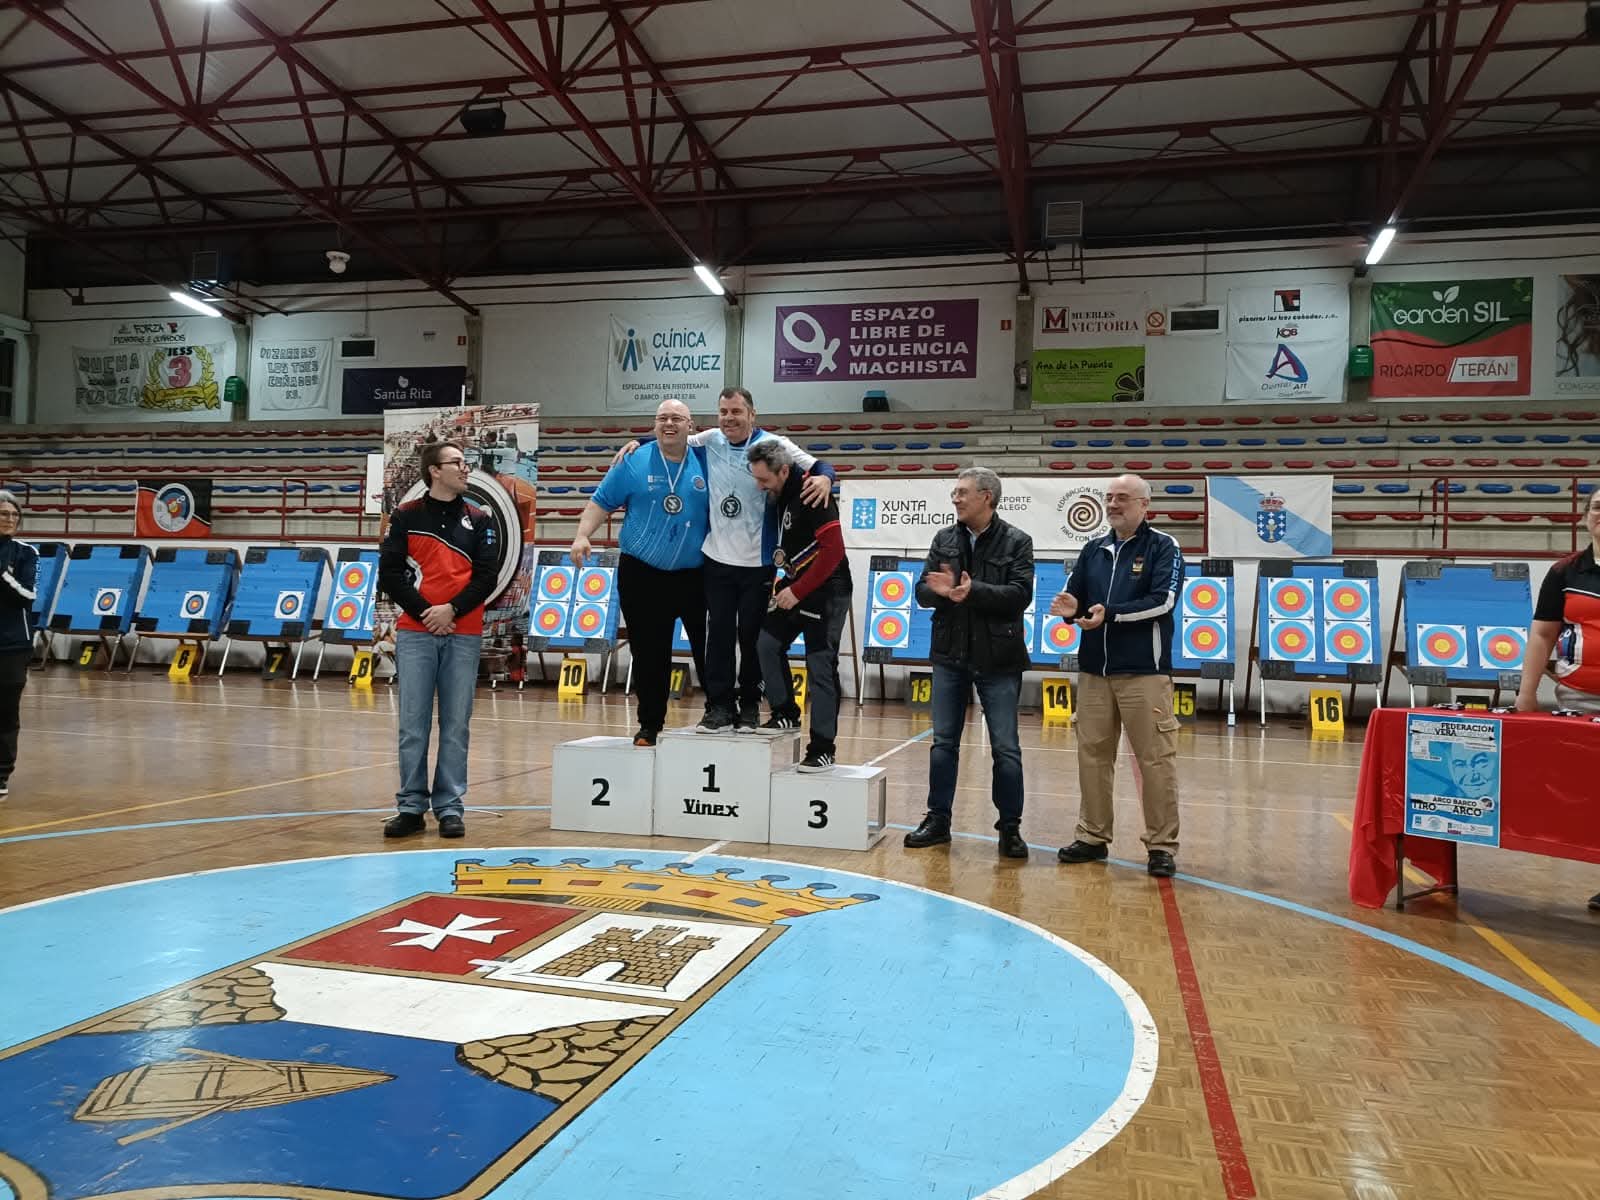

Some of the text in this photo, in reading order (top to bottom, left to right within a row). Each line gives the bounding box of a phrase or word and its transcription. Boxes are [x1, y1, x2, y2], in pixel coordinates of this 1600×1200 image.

[850, 306, 936, 322] ESPAZO
[1071, 311, 1116, 320] MUEBLES
[1473, 302, 1510, 323] SIL
[850, 324, 946, 340] LIBRE DE
[1071, 320, 1140, 333] VICTORIA
[850, 341, 970, 358] VIOLENCIA
[652, 352, 721, 374] VÁZQUEZ
[848, 359, 968, 376] MACHISTA
[1081, 359, 1113, 370] Puente
[1379, 361, 1510, 378] RICARDO TERÁN
[168, 356, 193, 388] 3
[374, 386, 432, 400] Santa Rita
[622, 383, 662, 391] ESPECIALISTAS
[662, 383, 671, 391] EN
[882, 500, 927, 512] XUNTA
[998, 503, 1028, 511] ALEGO
[881, 512, 955, 525] DE GALICIA
[79, 646, 93, 666] 5
[176, 650, 190, 669] 6
[269, 654, 283, 673] 7
[355, 658, 370, 678] 8
[563, 664, 583, 687] 10
[911, 679, 931, 703] 13
[1045, 685, 1069, 709] 14
[1173, 690, 1195, 716] 15
[1314, 696, 1340, 723] 16
[1435, 729, 1458, 738] VERA
[1440, 722, 1495, 734] FEDERACIÓN
[702, 764, 721, 792] 1
[591, 778, 611, 806] 2
[682, 798, 739, 818] Vinex
[1412, 801, 1437, 813] TIRO
[1452, 805, 1482, 818] ARCO
[1432, 796, 1452, 805] ARCO
[1453, 798, 1478, 808] BARCO
[807, 800, 828, 828] 3
